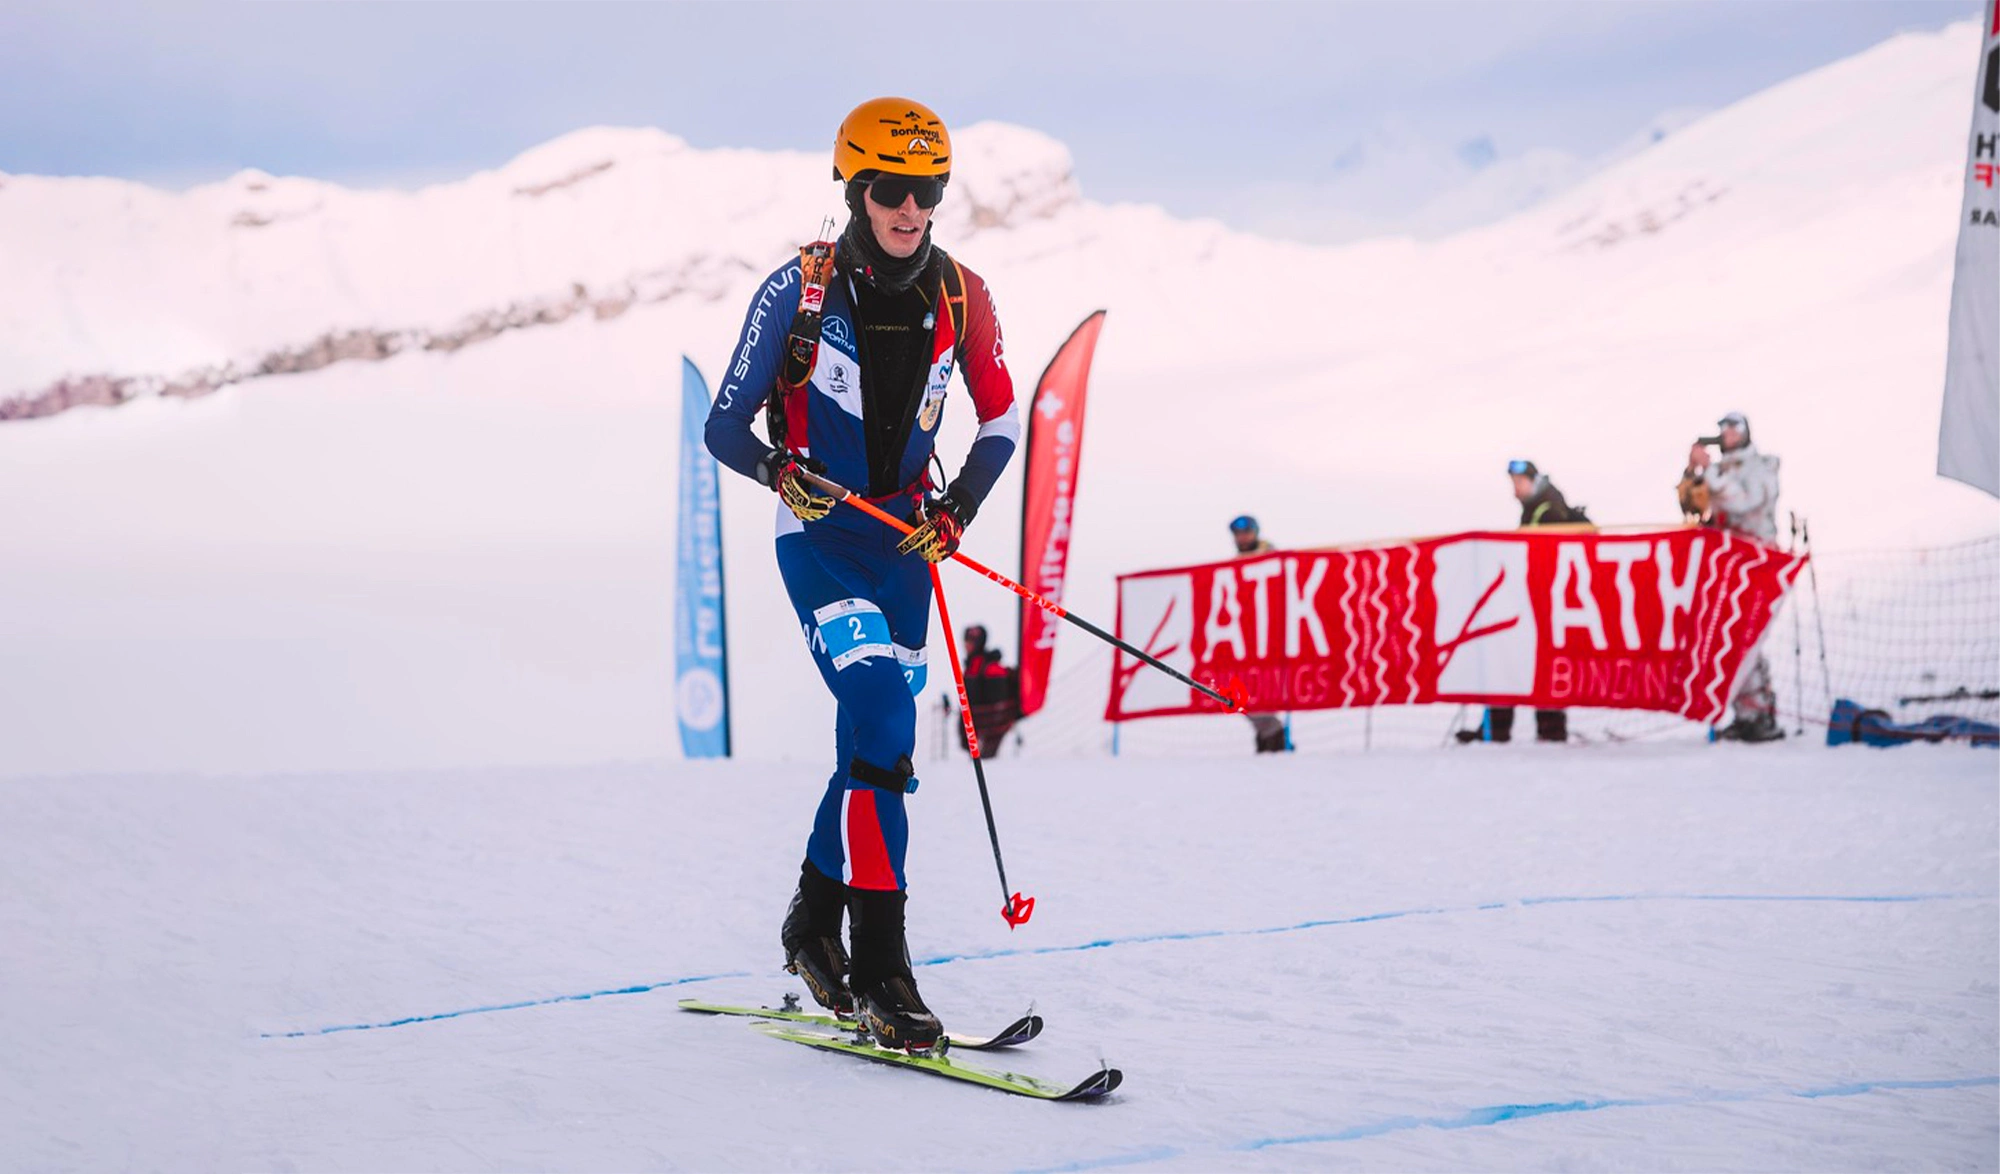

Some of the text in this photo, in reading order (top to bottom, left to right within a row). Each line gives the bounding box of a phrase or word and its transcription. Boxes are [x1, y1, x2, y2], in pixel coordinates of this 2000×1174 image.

[891, 128, 940, 139] Bonneval
[719, 265, 802, 410] LA SPORTIVA
[849, 616, 867, 641] 2
[1202, 557, 1331, 665] ATK
